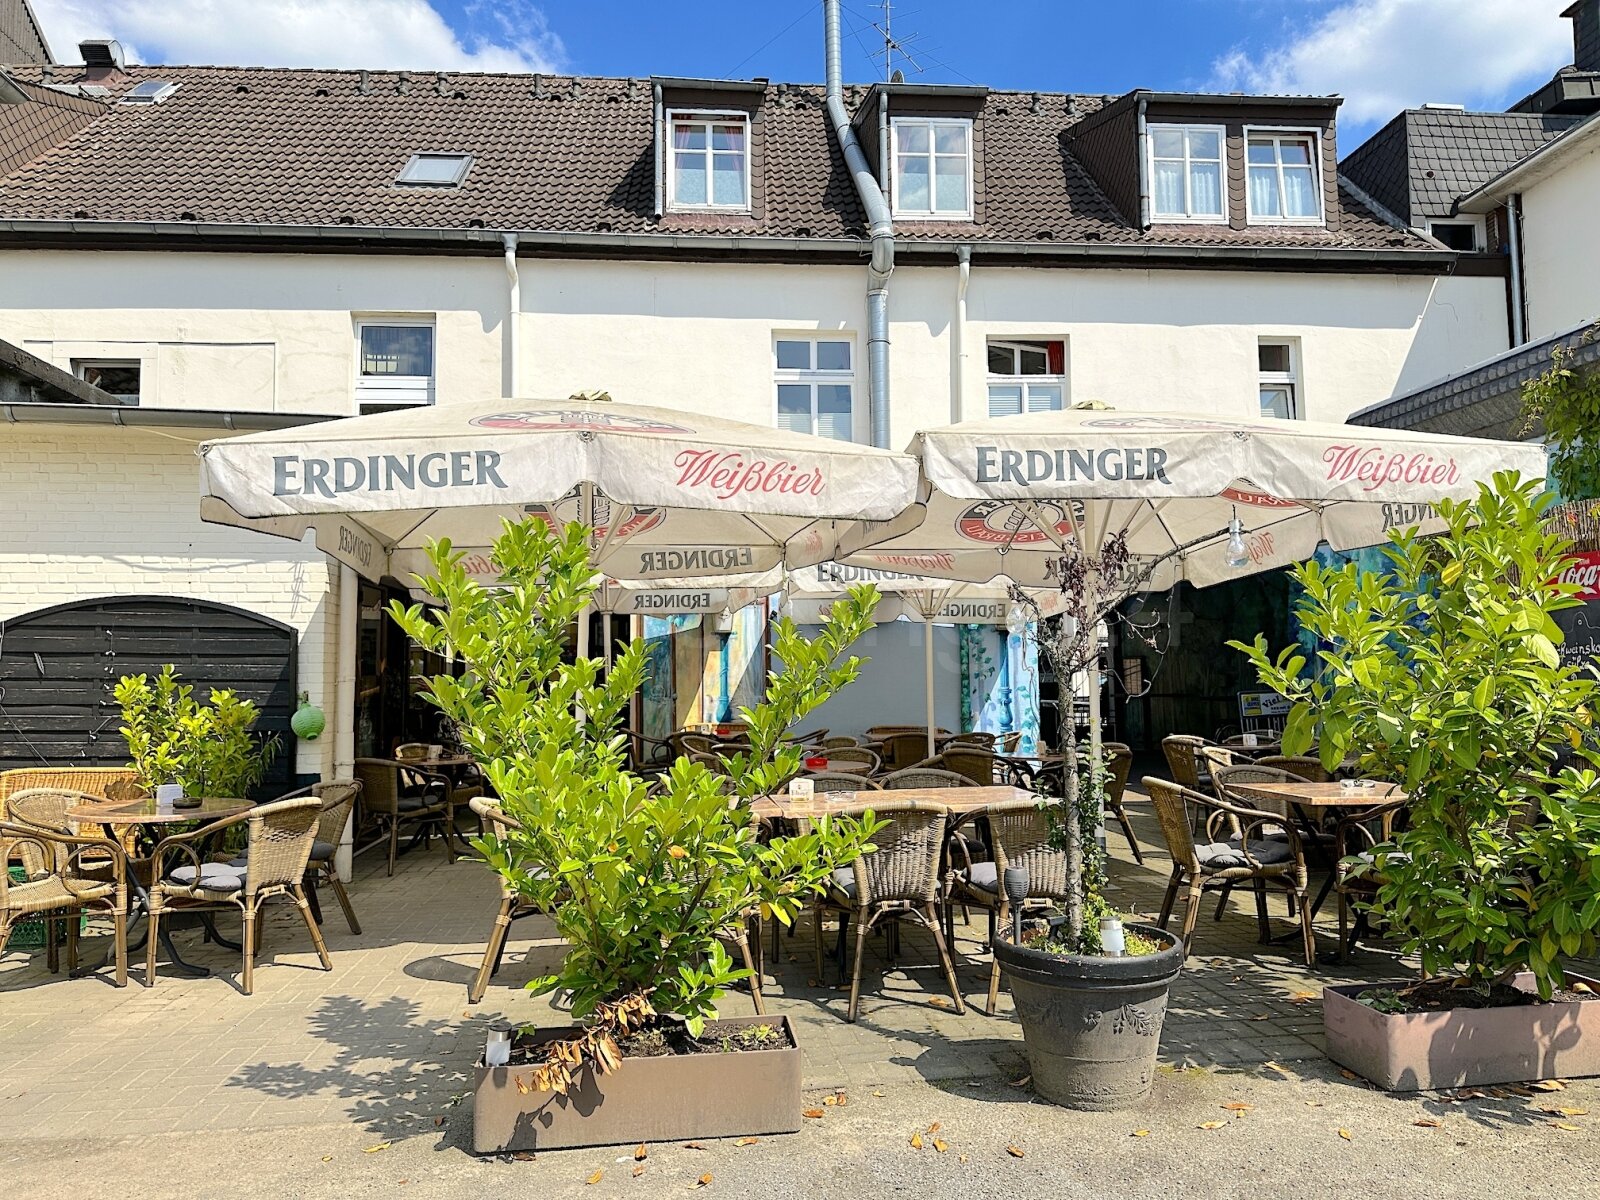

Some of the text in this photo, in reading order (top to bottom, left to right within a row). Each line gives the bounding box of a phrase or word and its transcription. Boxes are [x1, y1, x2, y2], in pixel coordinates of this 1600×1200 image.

[273, 449, 508, 499] ERDINGER
[673, 449, 826, 500] Weißbier
[975, 446, 1172, 487] ERDINGER
[1322, 444, 1461, 491] Weißbier
[816, 562, 924, 584] ERDING
